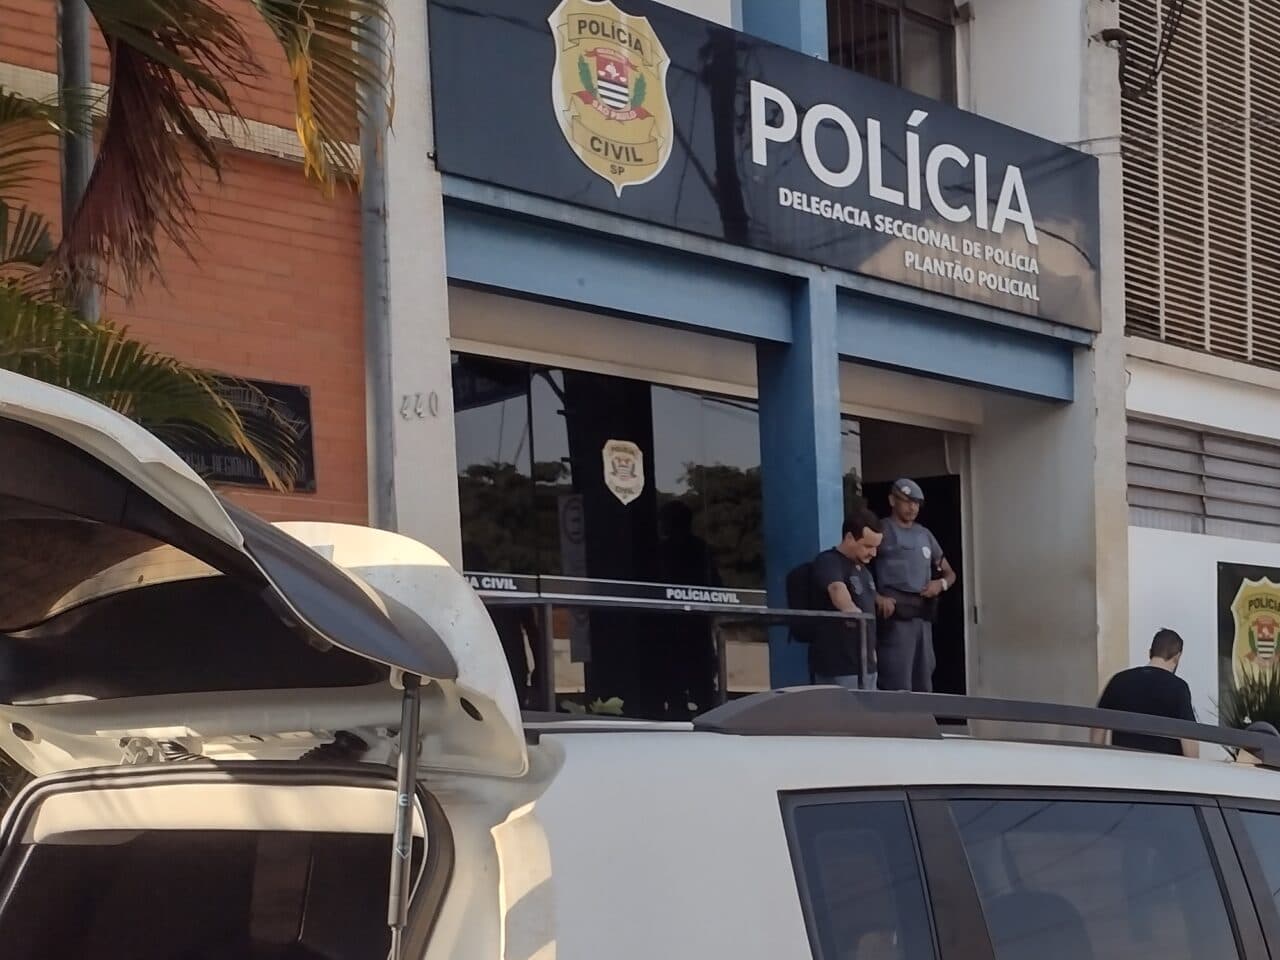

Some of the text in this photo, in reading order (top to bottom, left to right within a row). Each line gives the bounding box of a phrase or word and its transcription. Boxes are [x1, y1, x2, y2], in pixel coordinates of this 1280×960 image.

[577, 19, 644, 56] POLÍCIA
[590, 136, 643, 163] CIVIL
[750, 79, 1038, 244] POLÍCIA
[610, 164, 625, 176] SP
[778, 187, 1039, 275] DELEGACIA SECCIONAL DE POLÍCIA
[904, 250, 1040, 302] PLANTÃO POLICIAL
[482, 577, 518, 590] CIVIL
[666, 587, 740, 603] POLÍCIA CIVIL
